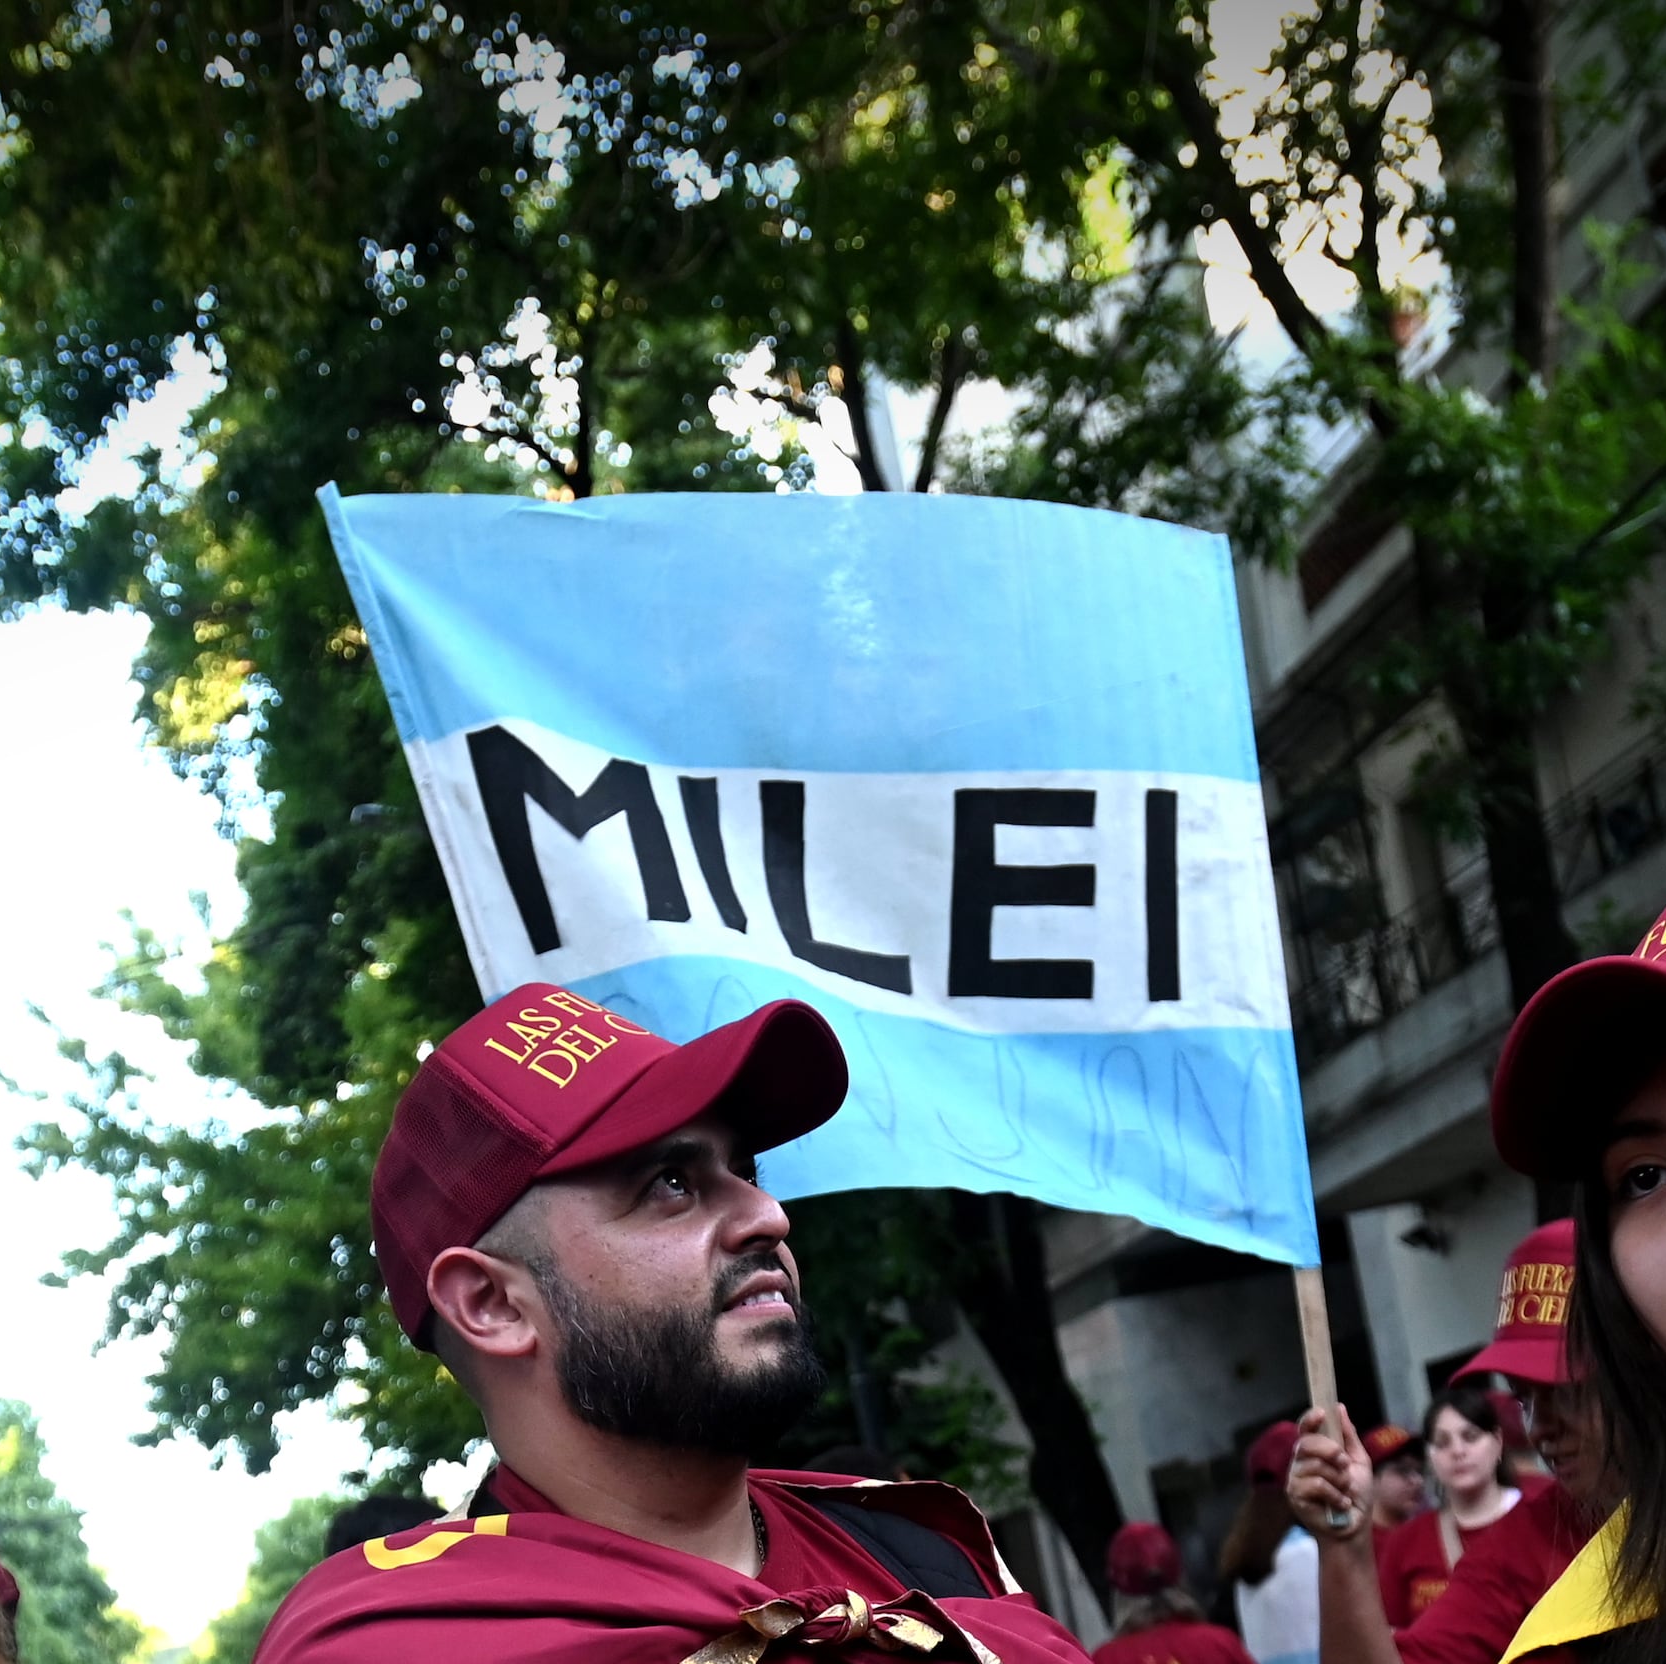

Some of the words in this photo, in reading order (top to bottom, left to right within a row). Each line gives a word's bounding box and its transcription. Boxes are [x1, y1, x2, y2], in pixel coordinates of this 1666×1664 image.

[466, 725, 1182, 1002] MILEI
[484, 1008, 562, 1065] LAS
[527, 1024, 619, 1090] DEL
